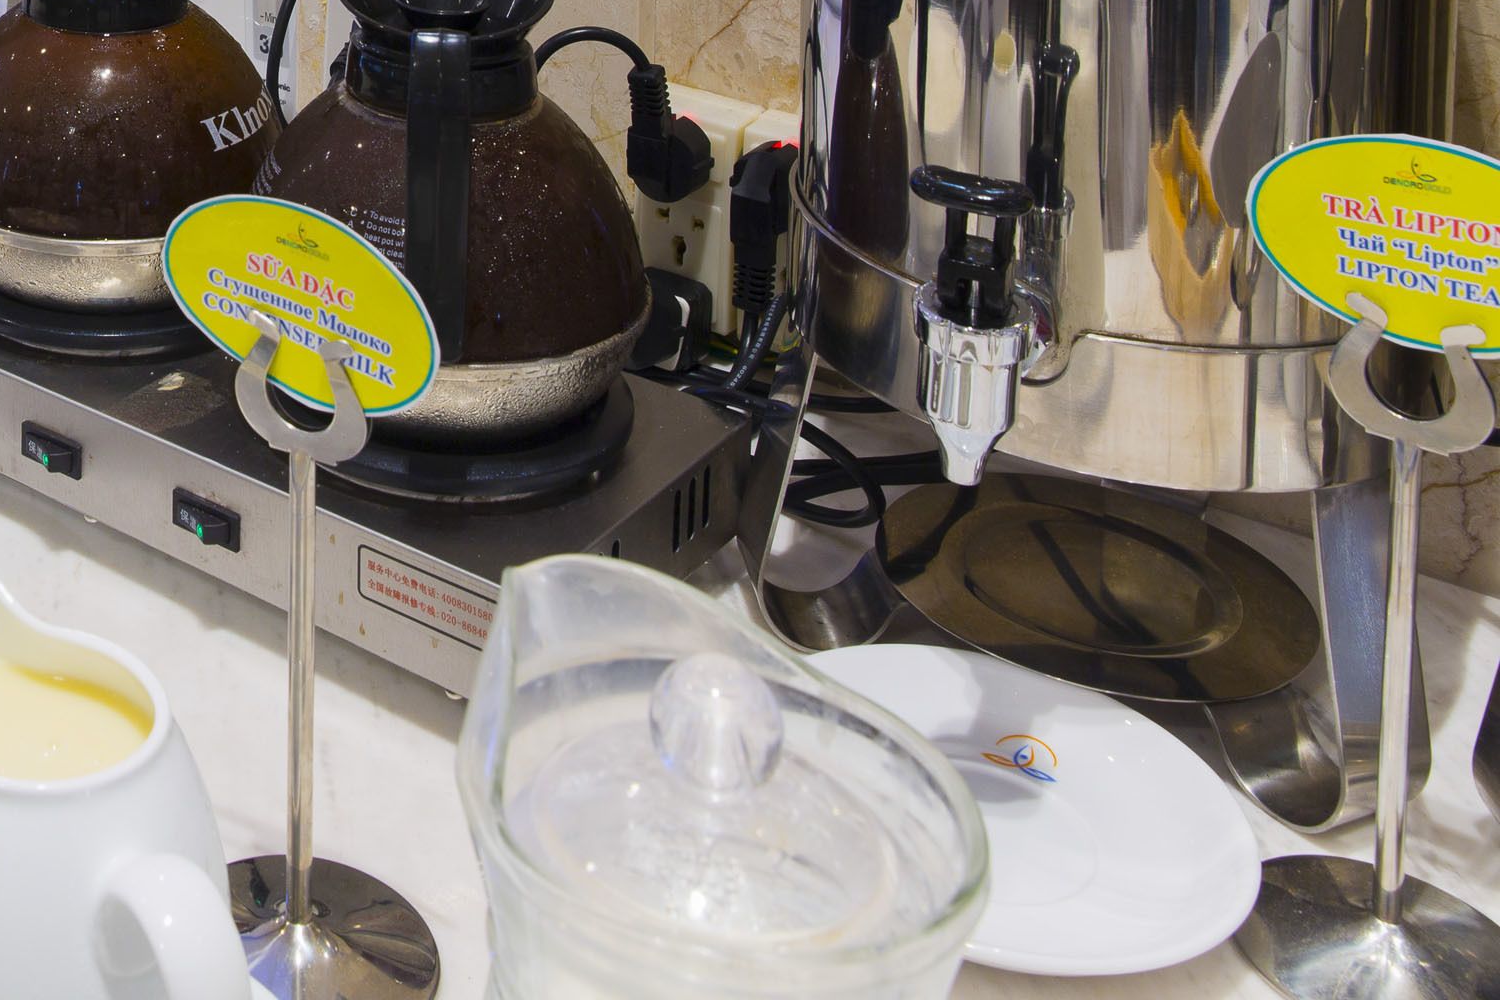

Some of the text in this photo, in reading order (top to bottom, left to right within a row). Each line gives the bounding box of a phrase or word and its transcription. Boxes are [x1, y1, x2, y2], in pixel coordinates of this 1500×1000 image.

[1324, 195, 1384, 225] TRÀ
[1339, 228, 1498, 273] Чай “Lipton”
[247, 253, 353, 309] SỮA ĐẶC
[1338, 257, 1500, 306] LIPTON TEA
[209, 269, 391, 355] Сгущенное Молоко
